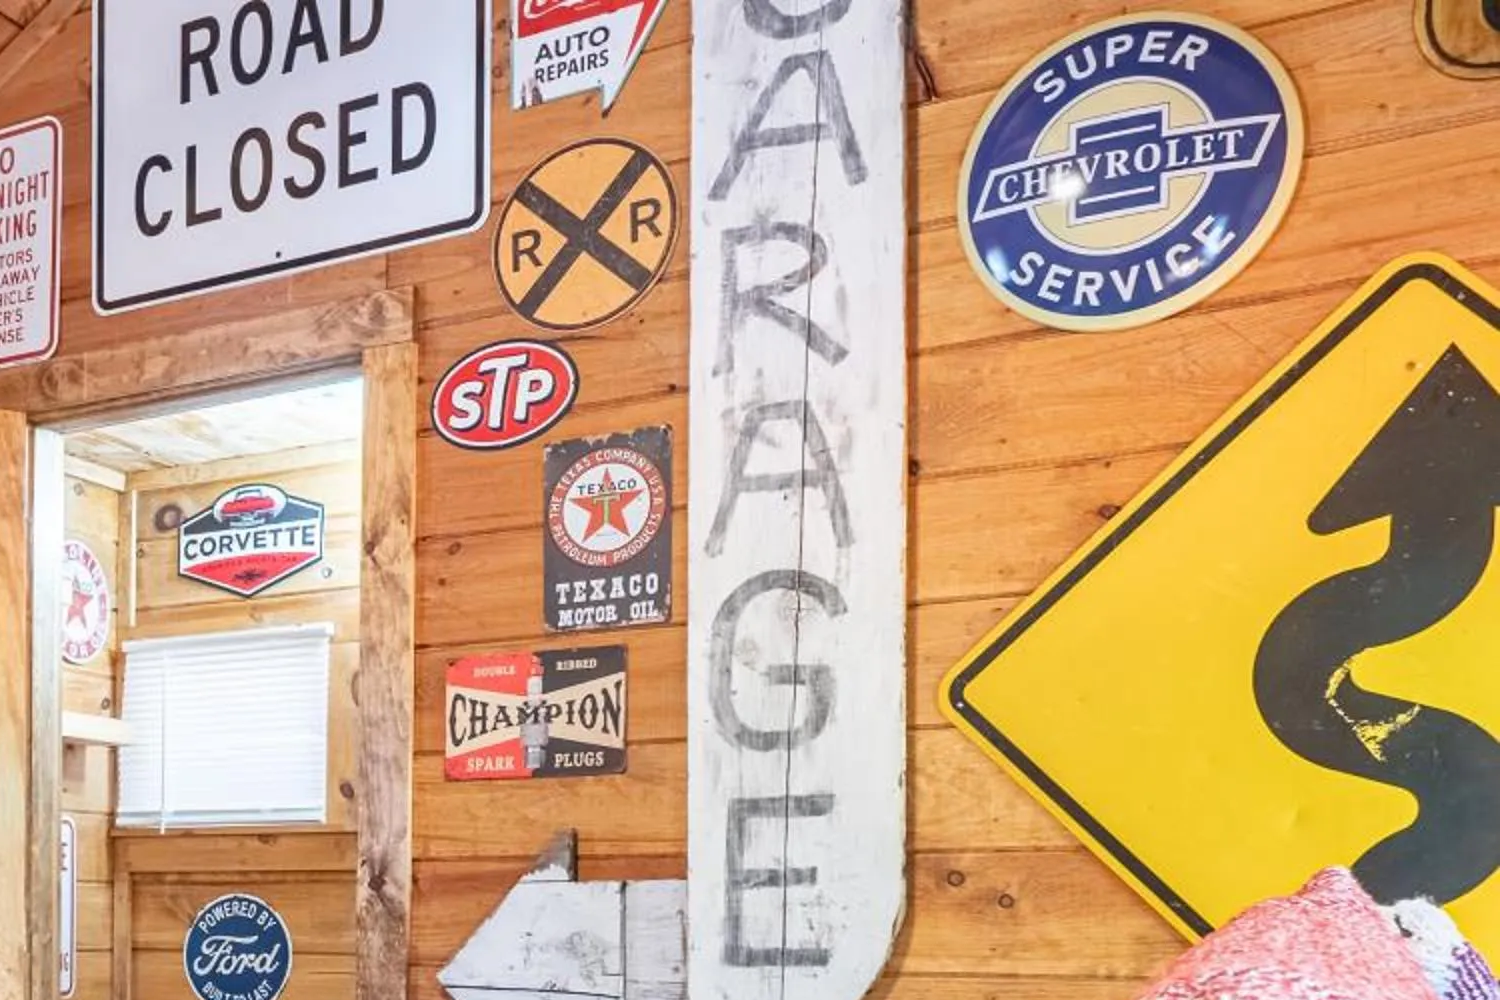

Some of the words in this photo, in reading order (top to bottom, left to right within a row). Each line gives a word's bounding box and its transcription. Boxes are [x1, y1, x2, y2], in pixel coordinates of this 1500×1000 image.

[180, 0, 385, 104] ROAD
[534, 26, 610, 64] AUTO
[534, 49, 609, 83] REPAIRS
[1033, 30, 1209, 103] SUPER
[134, 80, 438, 238] CLOSED
[511, 229, 543, 273] R
[629, 197, 663, 244] R
[0, 264, 41, 287] AWAY
[1009, 215, 1236, 307] SERVICE
[449, 353, 556, 432] STP
[577, 477, 637, 495] TEXACO
[704, 0, 868, 967] ARAGE
[183, 525, 317, 561] CORVETTE
[555, 572, 659, 605] TEXACO
[557, 605, 618, 628] MOTOR
[630, 600, 659, 619] OIL
[556, 658, 597, 671] RIBBED
[449, 679, 623, 747] CHAMPION
[466, 755, 516, 773] SPARK
[554, 751, 604, 768] PLUGS
[198, 900, 257, 934] POWERED
[257, 911, 277, 932] BY
[193, 935, 281, 976] Ford
